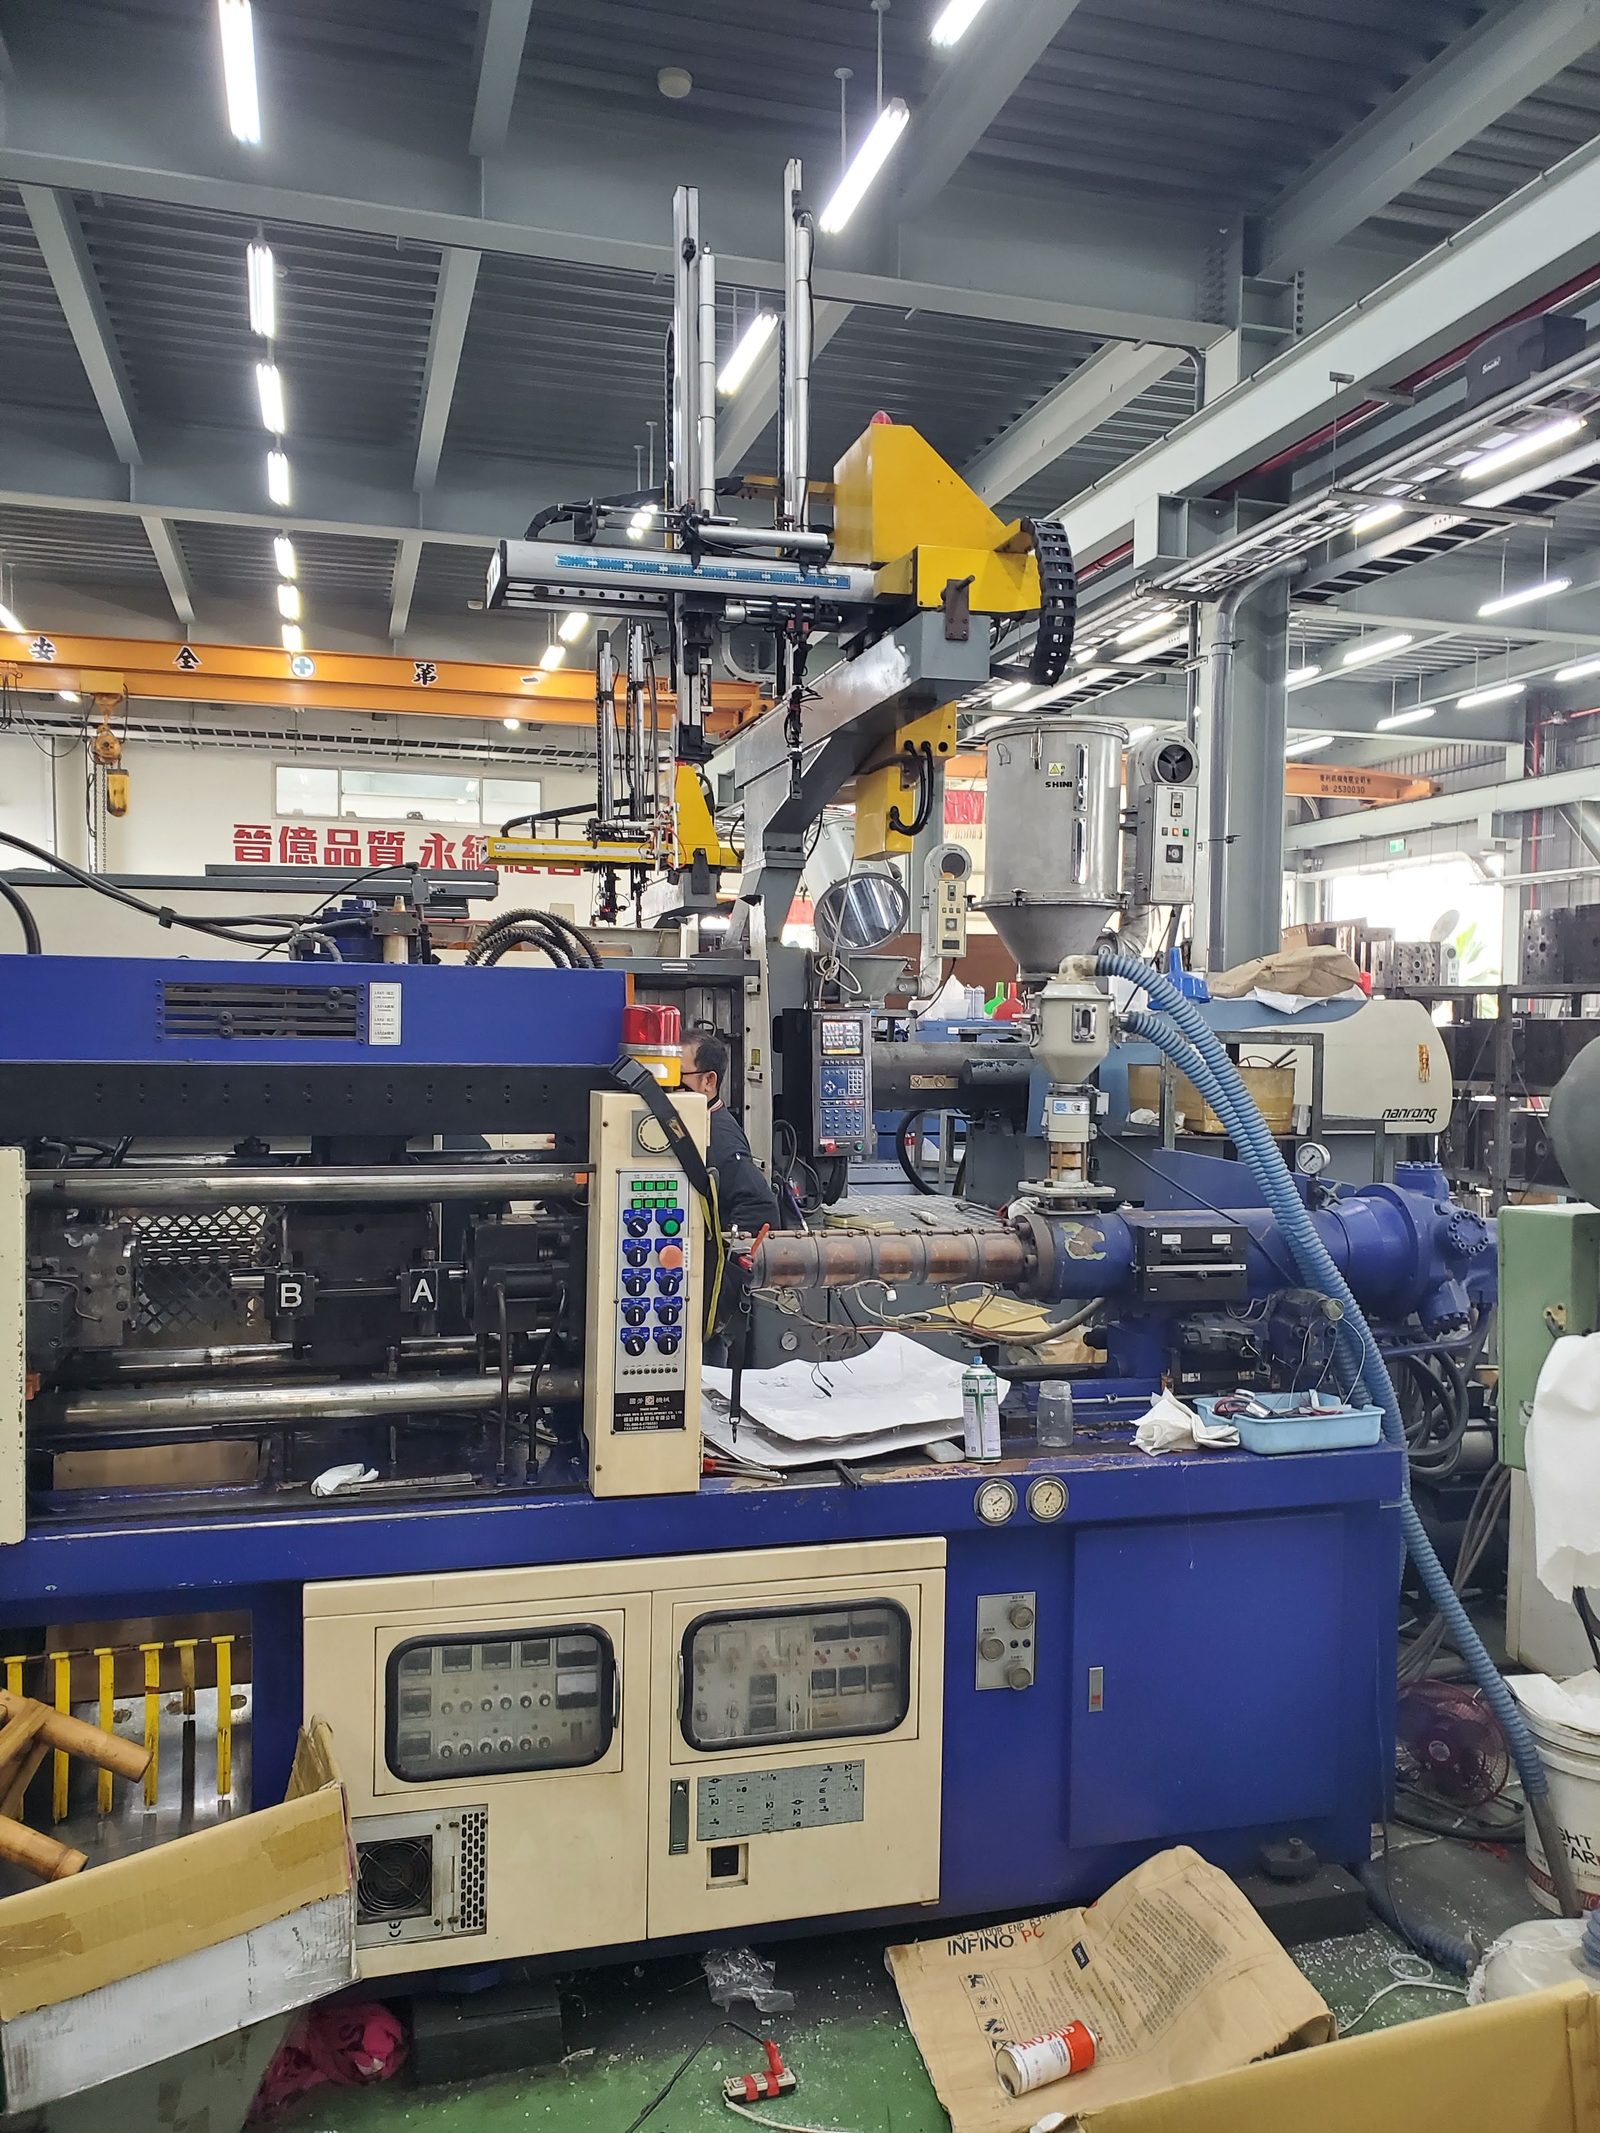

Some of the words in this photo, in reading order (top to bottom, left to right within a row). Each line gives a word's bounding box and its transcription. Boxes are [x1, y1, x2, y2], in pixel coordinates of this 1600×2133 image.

[30, 637, 56, 661] 安
[175, 646, 200, 670] 全
[412, 661, 438, 686] 第
[1382, 1108, 1438, 1124] nanrong
[280, 1282, 302, 1308] B
[411, 1278, 434, 1304] A
[947, 1934, 1014, 1957] INFINO
[1021, 1924, 1045, 1943] PC
